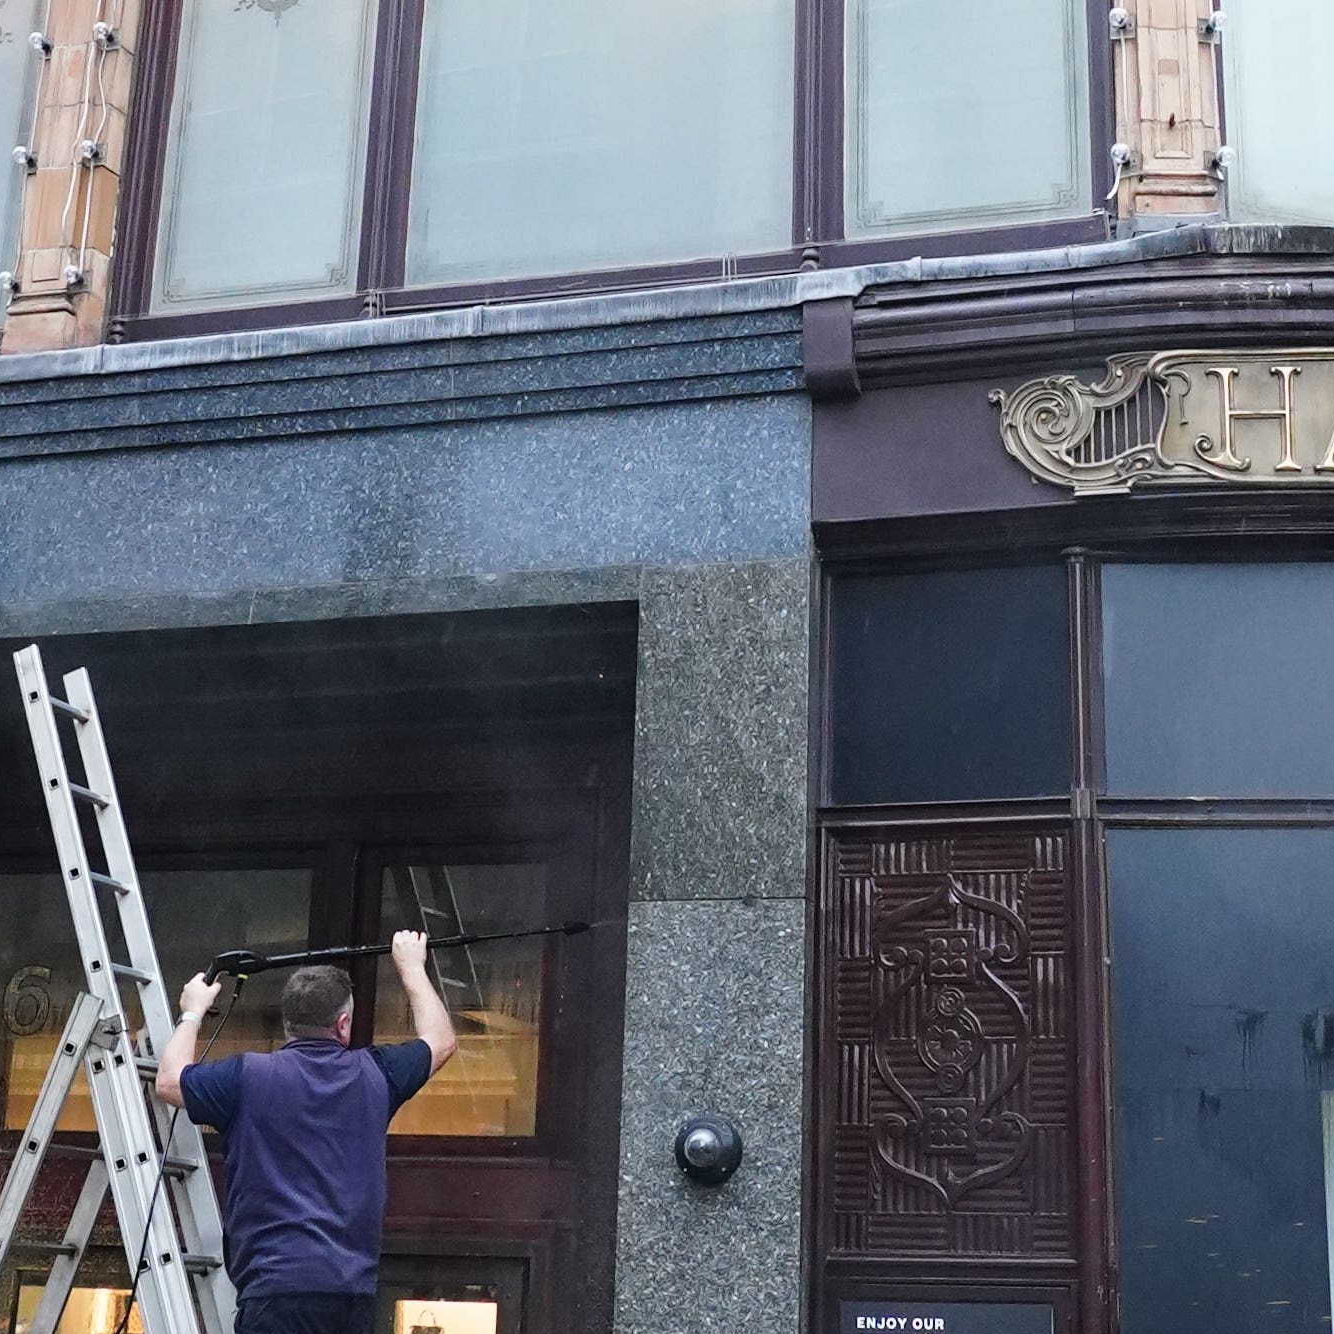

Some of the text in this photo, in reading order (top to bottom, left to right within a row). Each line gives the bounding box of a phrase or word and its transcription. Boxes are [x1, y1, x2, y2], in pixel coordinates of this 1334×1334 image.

[3, 965, 52, 1036] 6
[856, 1317, 945, 1331] ENJOY OUR
